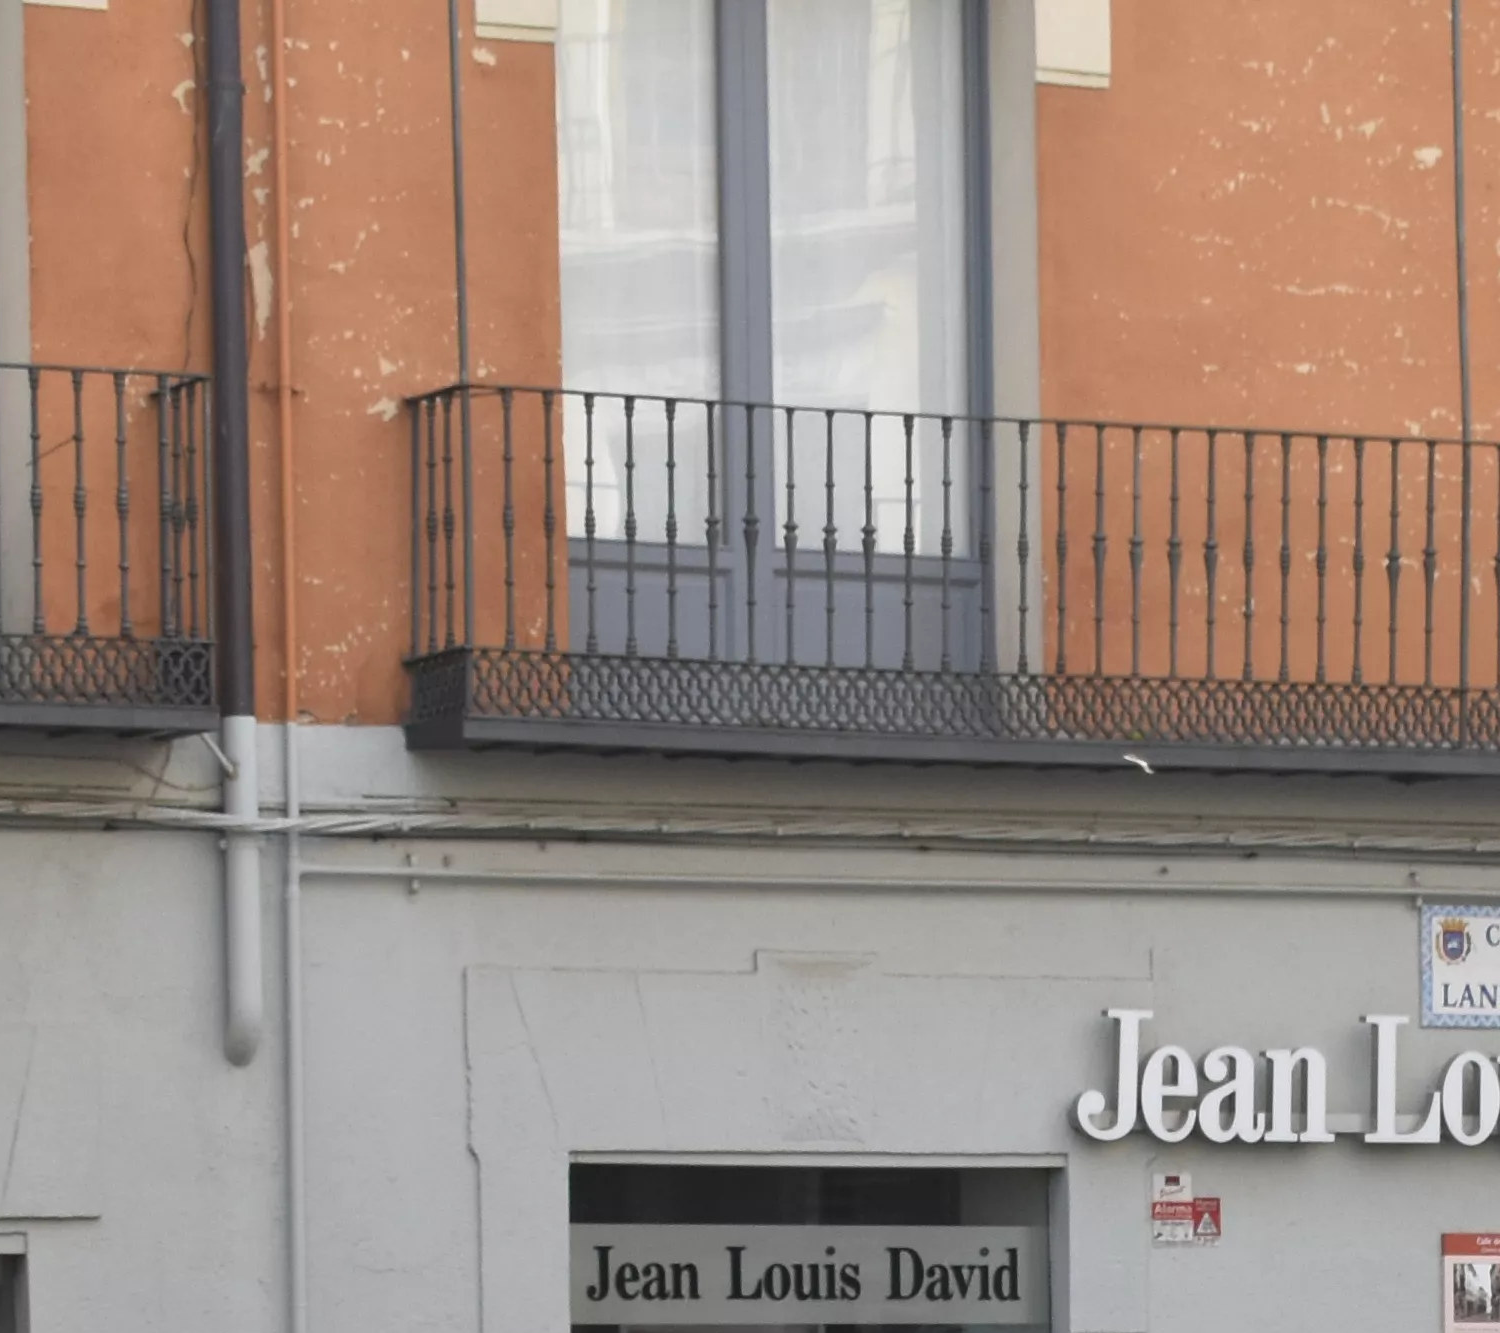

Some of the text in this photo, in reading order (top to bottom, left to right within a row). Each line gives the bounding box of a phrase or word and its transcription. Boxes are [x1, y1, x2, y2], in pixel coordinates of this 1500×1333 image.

[1076, 1008, 1336, 1143] Jean
[586, 1245, 1020, 1301] Jean Louis David
